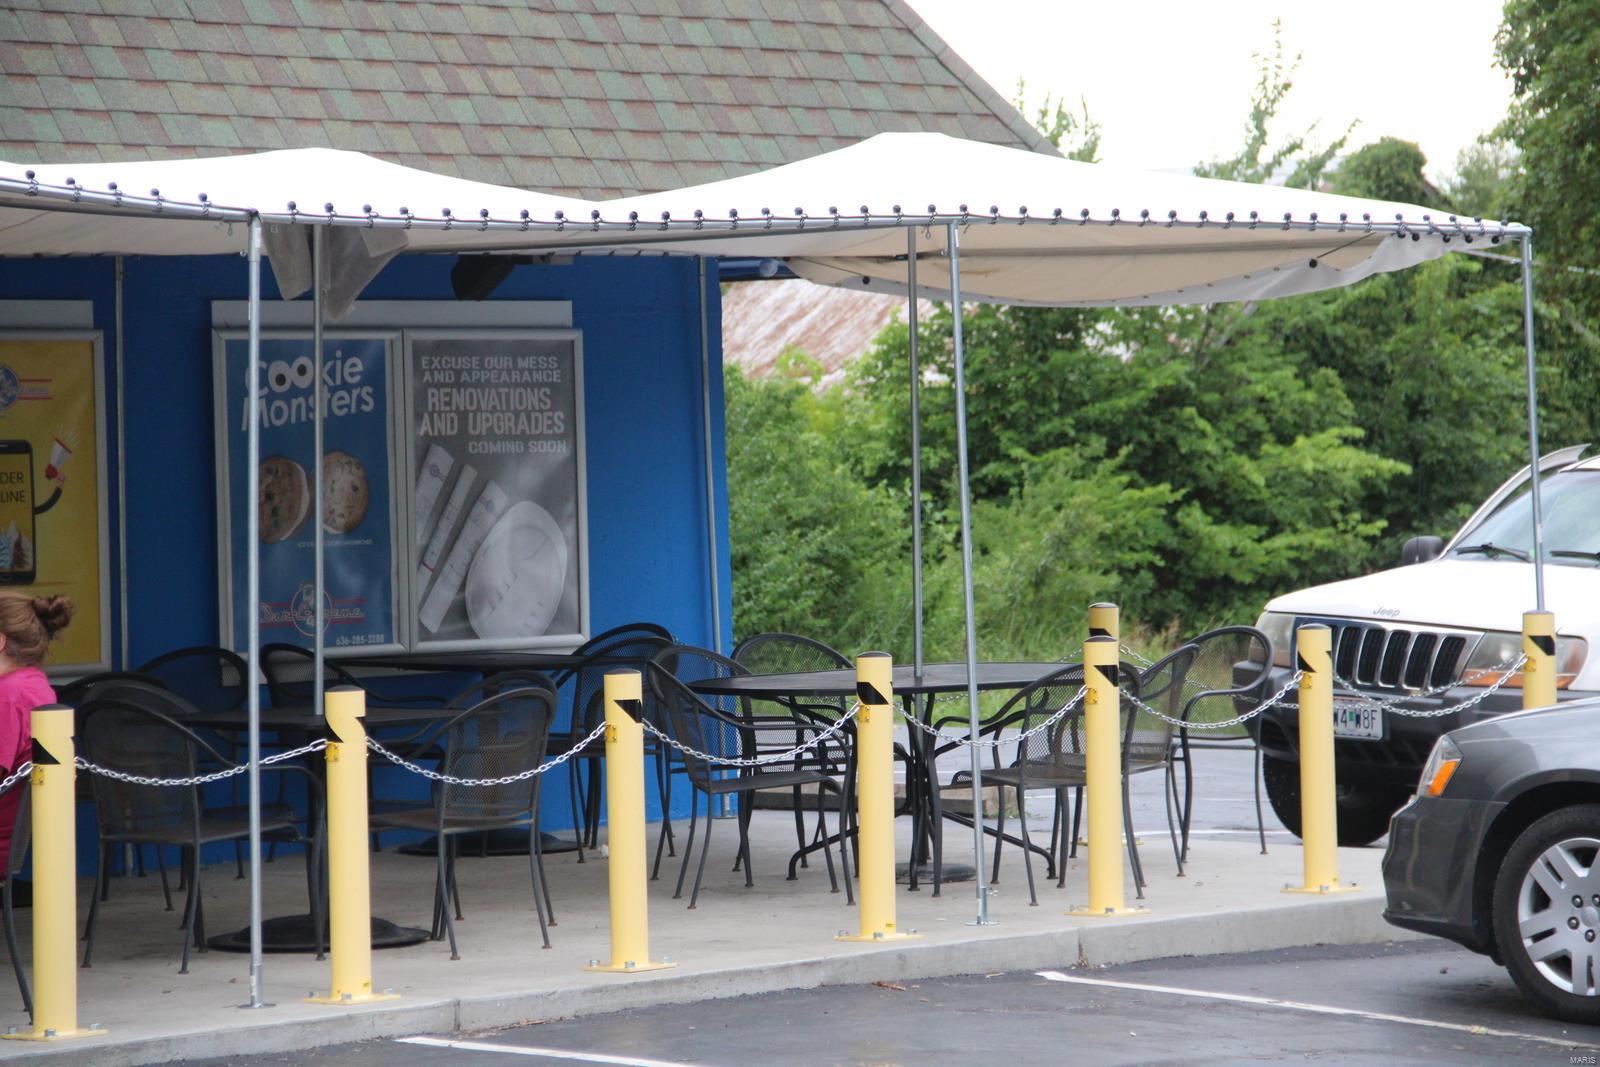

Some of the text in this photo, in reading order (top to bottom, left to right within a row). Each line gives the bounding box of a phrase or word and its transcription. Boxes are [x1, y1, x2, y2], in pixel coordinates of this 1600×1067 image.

[421, 356, 558, 369] EXCUSE OUR MESS
[244, 350, 364, 397] Cookie
[422, 369, 562, 383] AND APPEARANCE
[241, 385, 375, 432] Monsters
[427, 387, 551, 412] RENOVATIONS
[419, 411, 565, 437] AND UPGRADES
[468, 440, 567, 454] COMING SOON
[1373, 606, 1400, 618] Jeep
